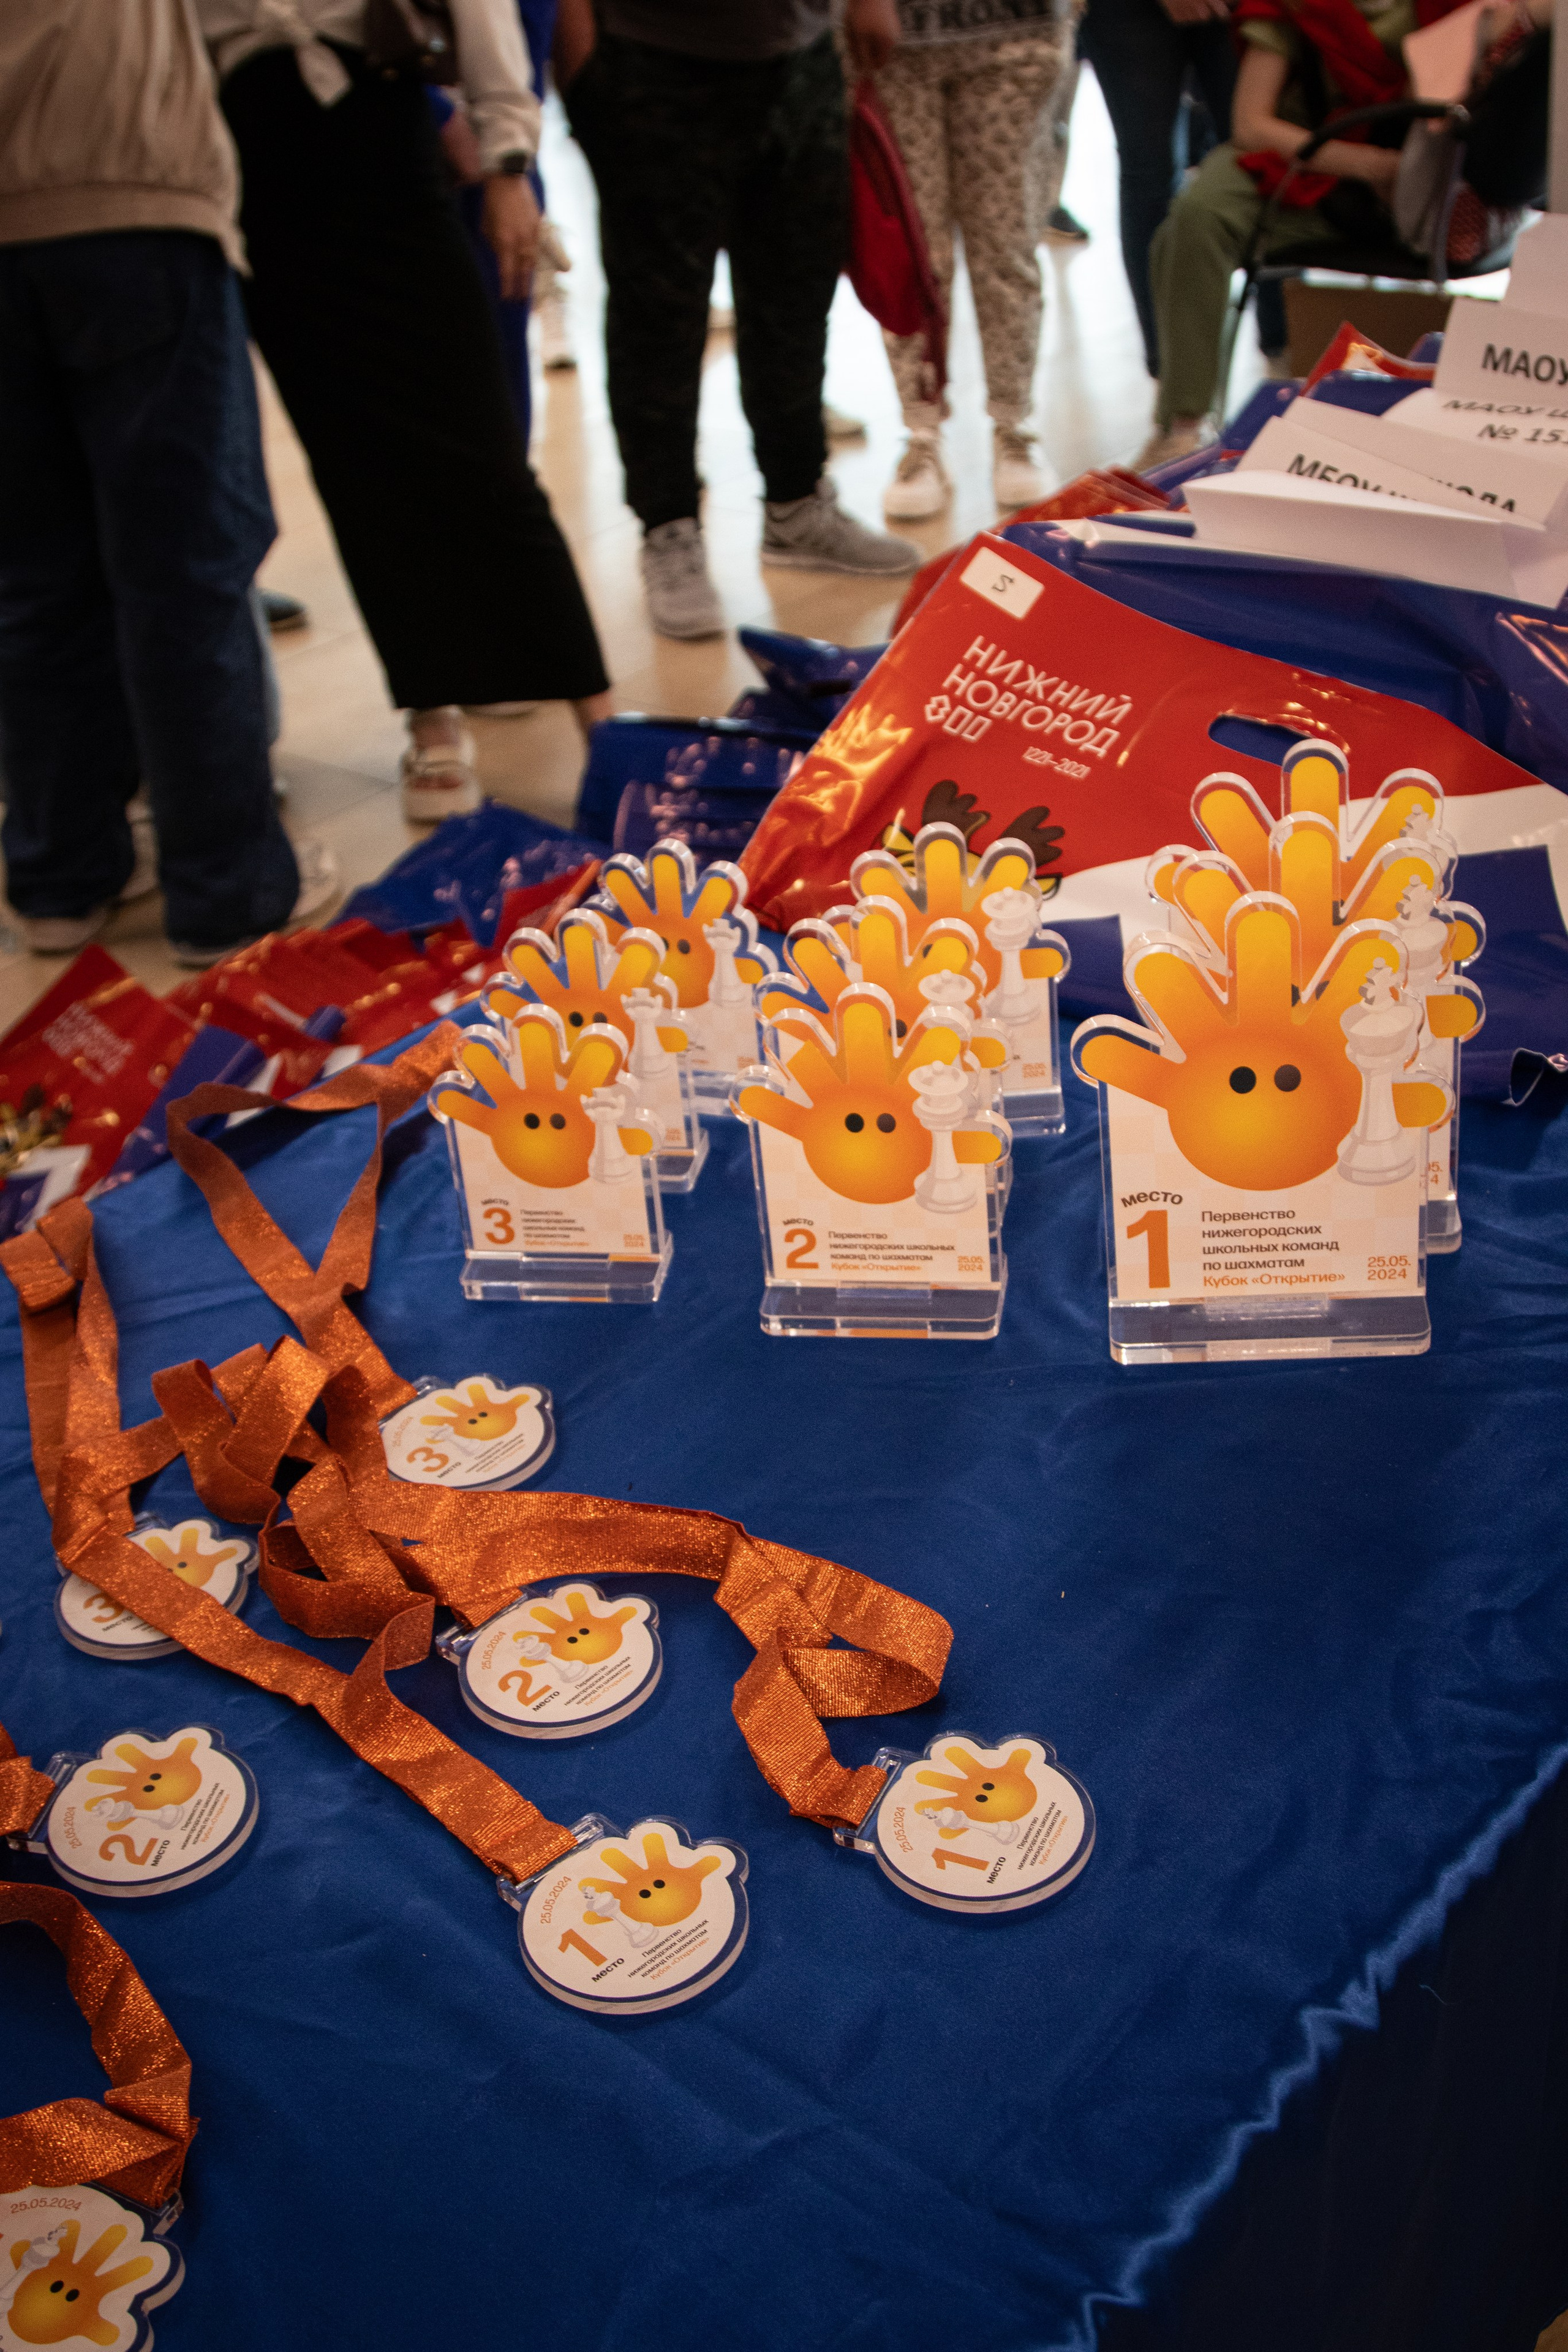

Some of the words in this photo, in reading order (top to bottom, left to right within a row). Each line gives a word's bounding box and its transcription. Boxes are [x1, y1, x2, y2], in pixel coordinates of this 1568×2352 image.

[1481, 342, 1568, 386] МАОУ
[963, 635, 1133, 725] НИЖНИЙ
[941, 663, 1121, 759] НОВГОРОД
[1121, 1191, 1183, 1208] место
[483, 1208, 515, 1245] 3
[782, 1217, 814, 1226] место
[1202, 1210, 1295, 1223] Первенство
[1202, 1225, 1322, 1238] нижегородских
[785, 1228, 820, 1269] 2
[1126, 1209, 1170, 1289] 1
[1203, 1244, 1278, 1255] школьных
[1282, 1241, 1340, 1252] команд
[1203, 1262, 1221, 1271] по
[1224, 1259, 1305, 1270] шахматам
[1367, 1269, 1407, 1280] 2024
[1368, 1256, 1411, 1268] 25.05.
[1203, 1275, 1248, 1288] Кубок
[1252, 1273, 1345, 1285] «Открытие»
[406, 1446, 450, 1472] 3
[83, 1593, 124, 1623] 3
[498, 1670, 552, 1707] 2
[532, 1691, 560, 1711] место
[894, 1807, 913, 1853] 25.05.2024
[99, 1834, 159, 1866] 2
[151, 1840, 170, 1866] место
[932, 1847, 990, 1871] 1
[986, 1856, 1006, 1884] место
[540, 1875, 572, 1924] 25.05.2024
[558, 1928, 608, 1967] 1
[628, 1942, 677, 1978] нижегородских
[677, 1920, 709, 1943] школьных
[641, 1959, 666, 1978] команд
[666, 1952, 675, 1961] по
[674, 1929, 708, 1954] шахматам
[642, 1929, 682, 1958] Первенство
[592, 1958, 625, 1982] место
[650, 1966, 671, 1980] Кубок
[10, 2198, 82, 2214] 25.05.2024
